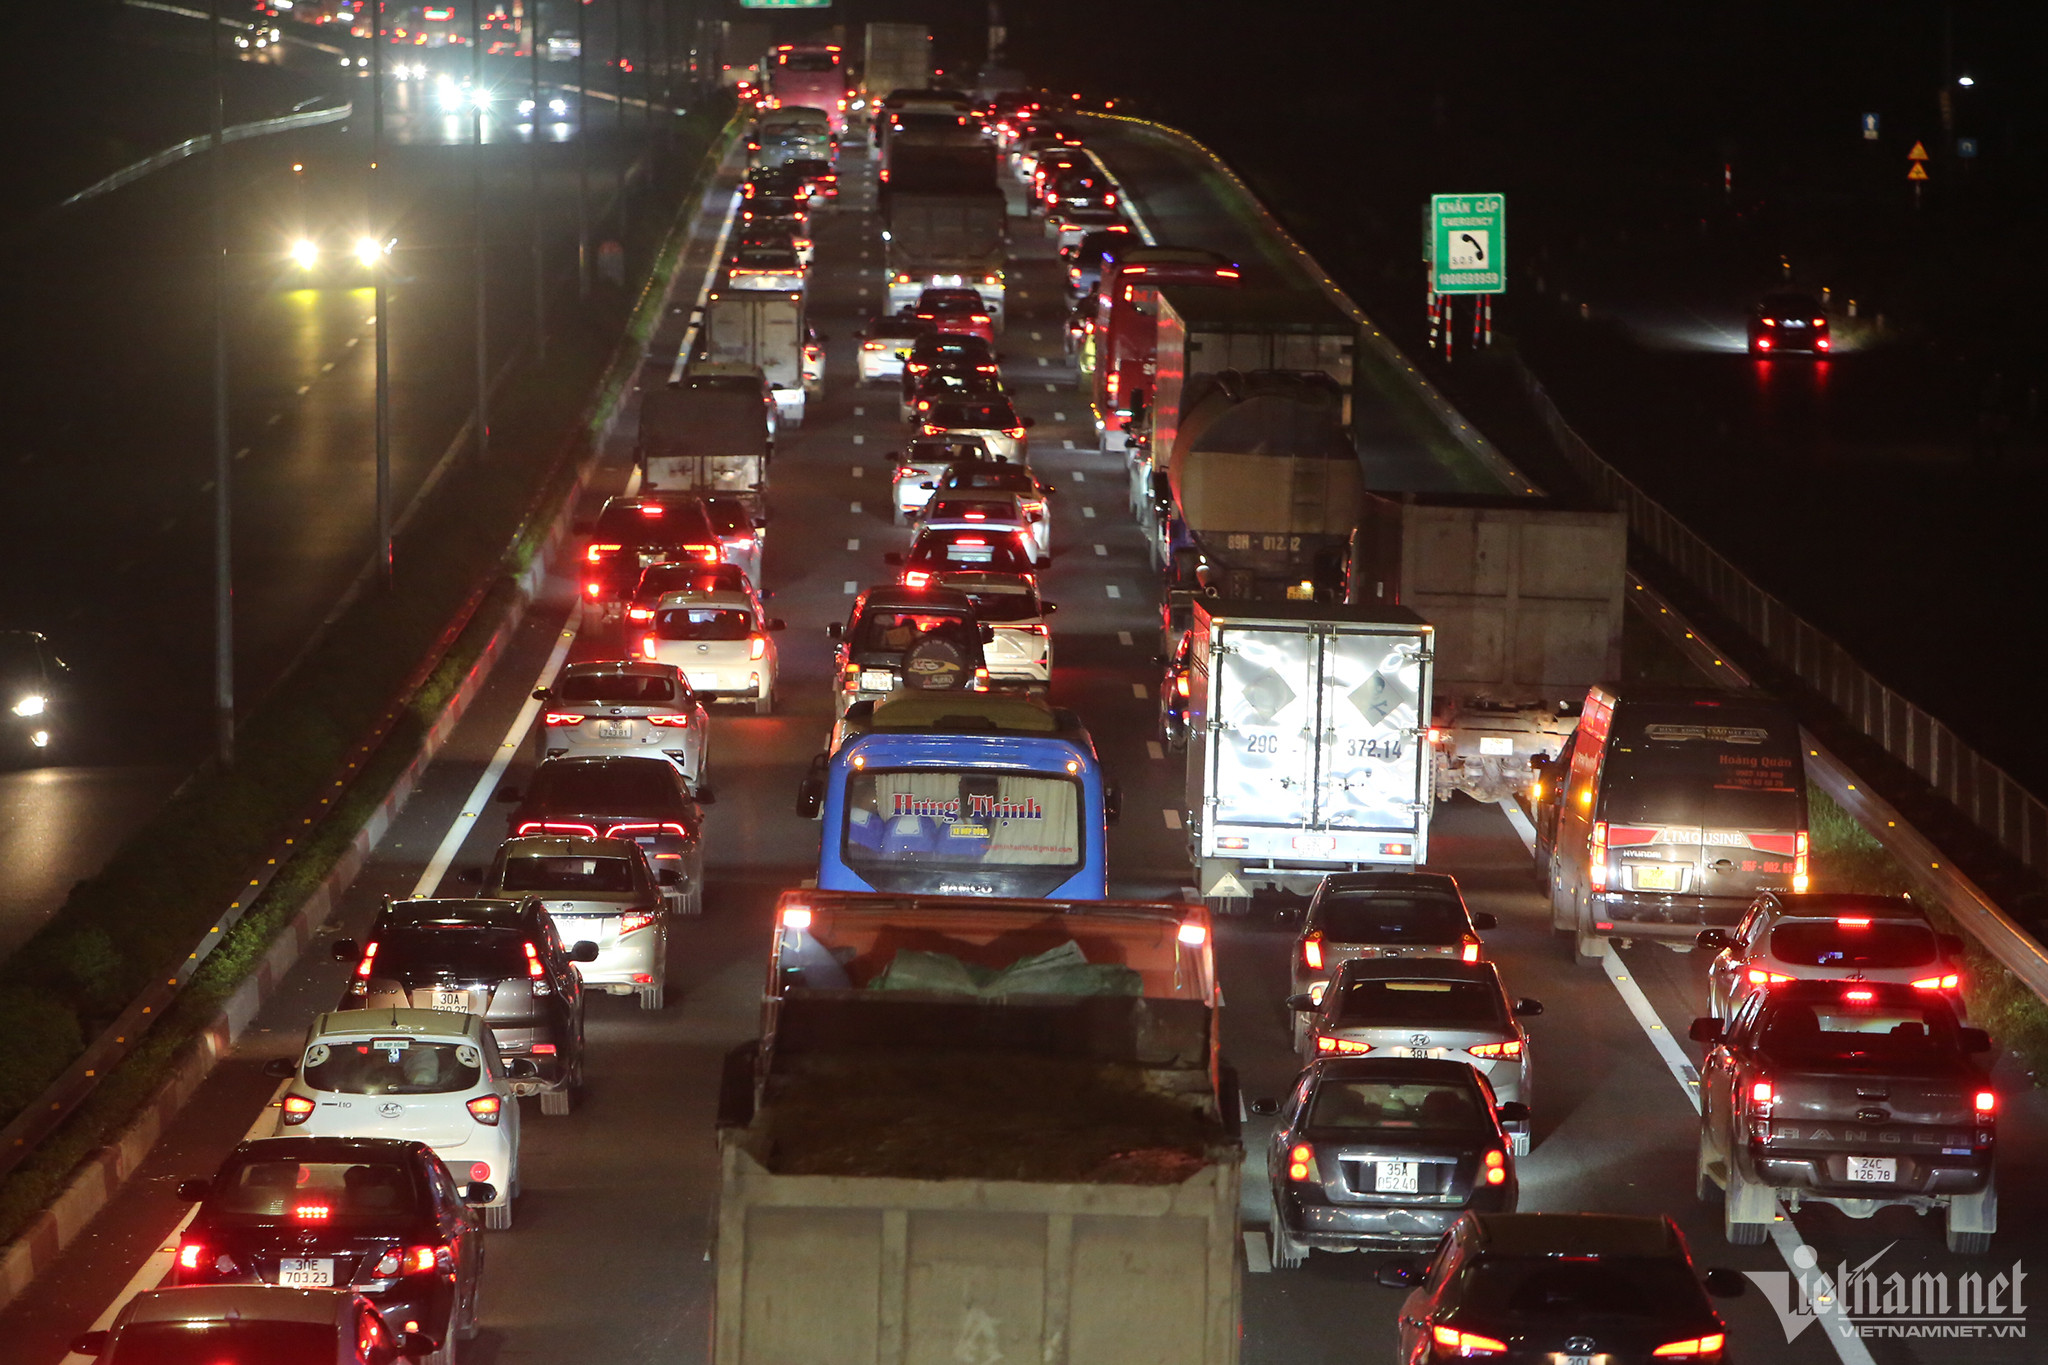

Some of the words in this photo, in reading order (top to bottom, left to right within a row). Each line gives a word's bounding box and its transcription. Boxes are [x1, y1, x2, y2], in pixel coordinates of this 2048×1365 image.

[1442, 217, 1493, 227] EMERGENCY
[1248, 734, 1278, 753] 29C
[1347, 739, 1402, 758] 372.14
[892, 793, 960, 823] Hưng
[968, 793, 1042, 827] Thịnh
[1663, 830, 1743, 845] LIMOUSINE
[1623, 850, 1662, 858] HYUNDAI
[440, 994, 460, 1004] 30A
[1778, 1127, 1969, 1146] RANGER
[1387, 1163, 1408, 1176] 35A
[1862, 1159, 1882, 1169] 24C
[1854, 1170, 1890, 1181] 126.78
[295, 1260, 318, 1271] 30E
[285, 1272, 328, 1284] 703.23
